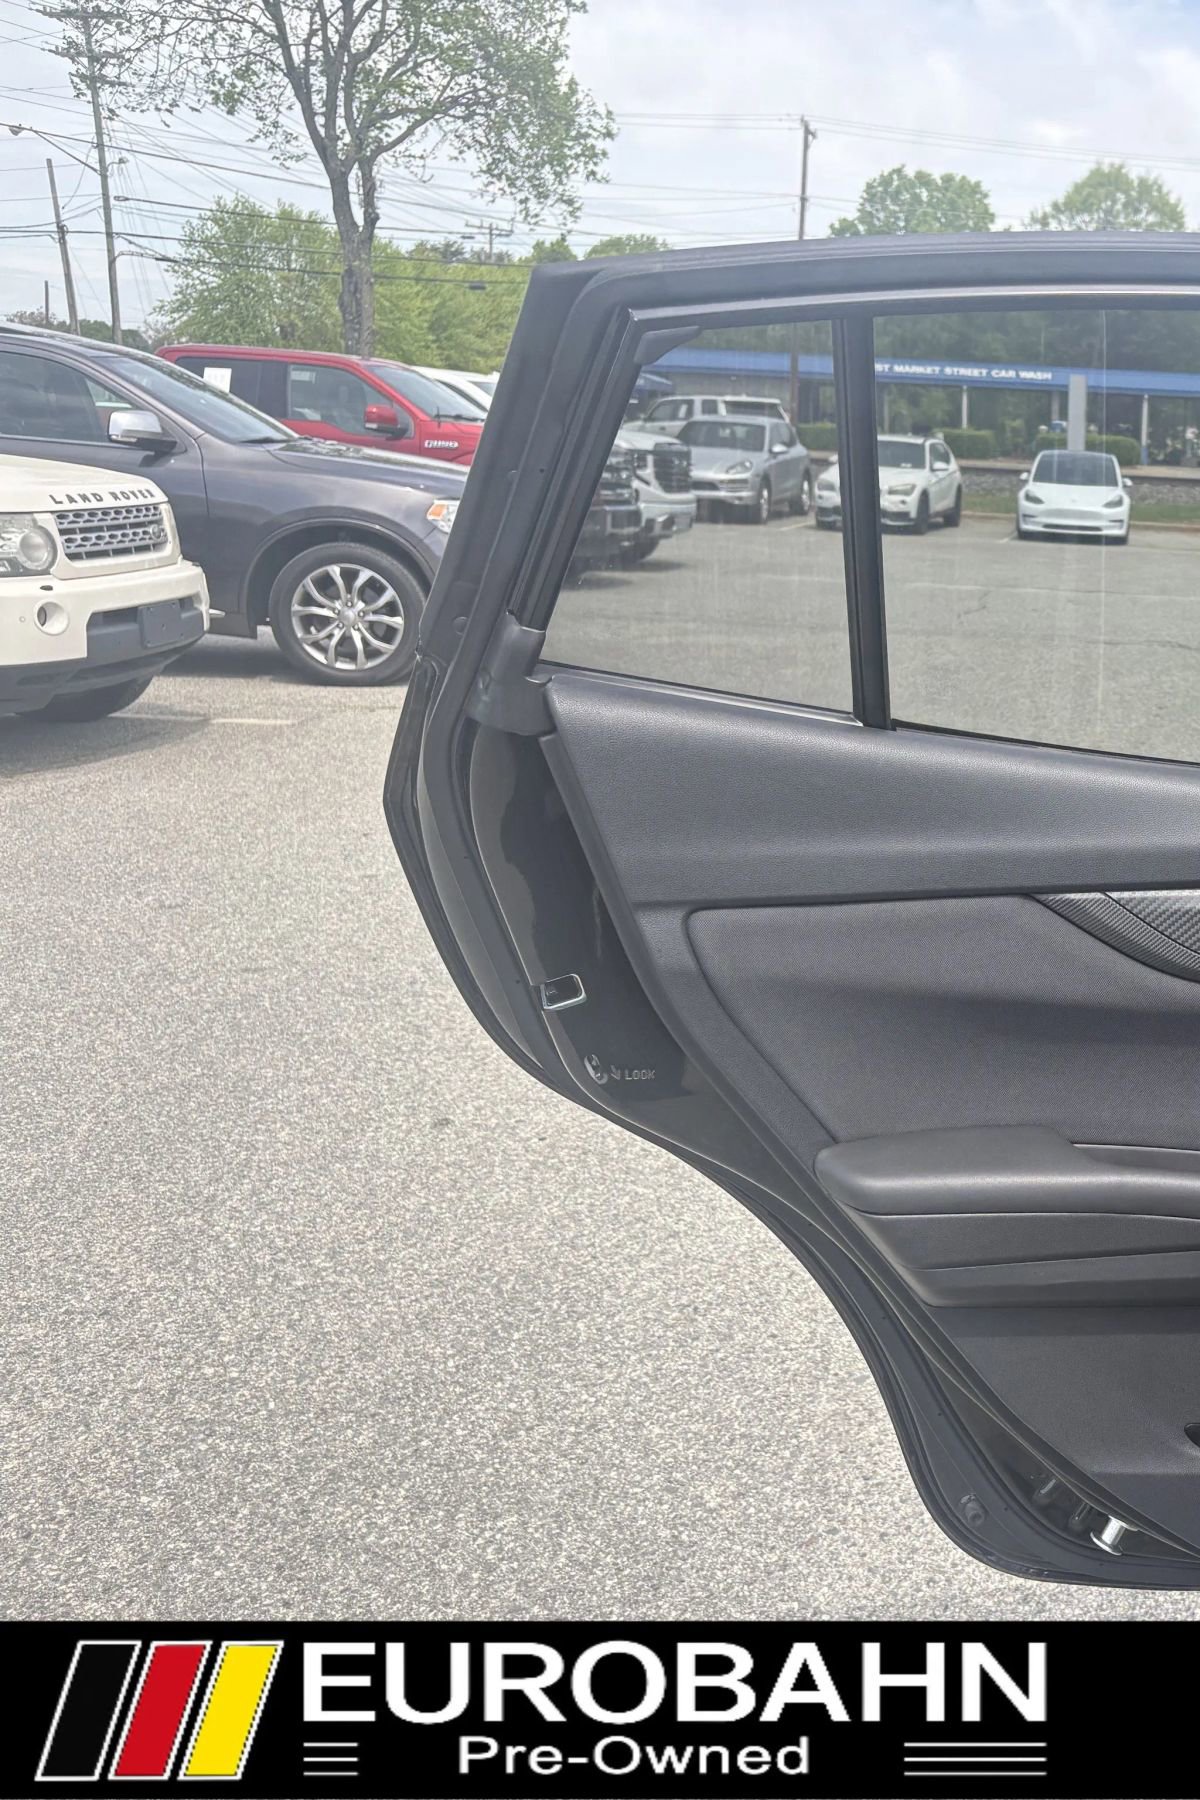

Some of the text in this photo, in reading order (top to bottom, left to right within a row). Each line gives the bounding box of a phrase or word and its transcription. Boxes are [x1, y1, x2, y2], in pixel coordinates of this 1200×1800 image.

[893, 364, 940, 375] MARKET
[944, 366, 988, 377] STREET
[991, 369, 1016, 379] CAR
[1018, 370, 1052, 381] WASH
[49, 492, 103, 505] LAND
[624, 1069, 656, 1080] LOCK
